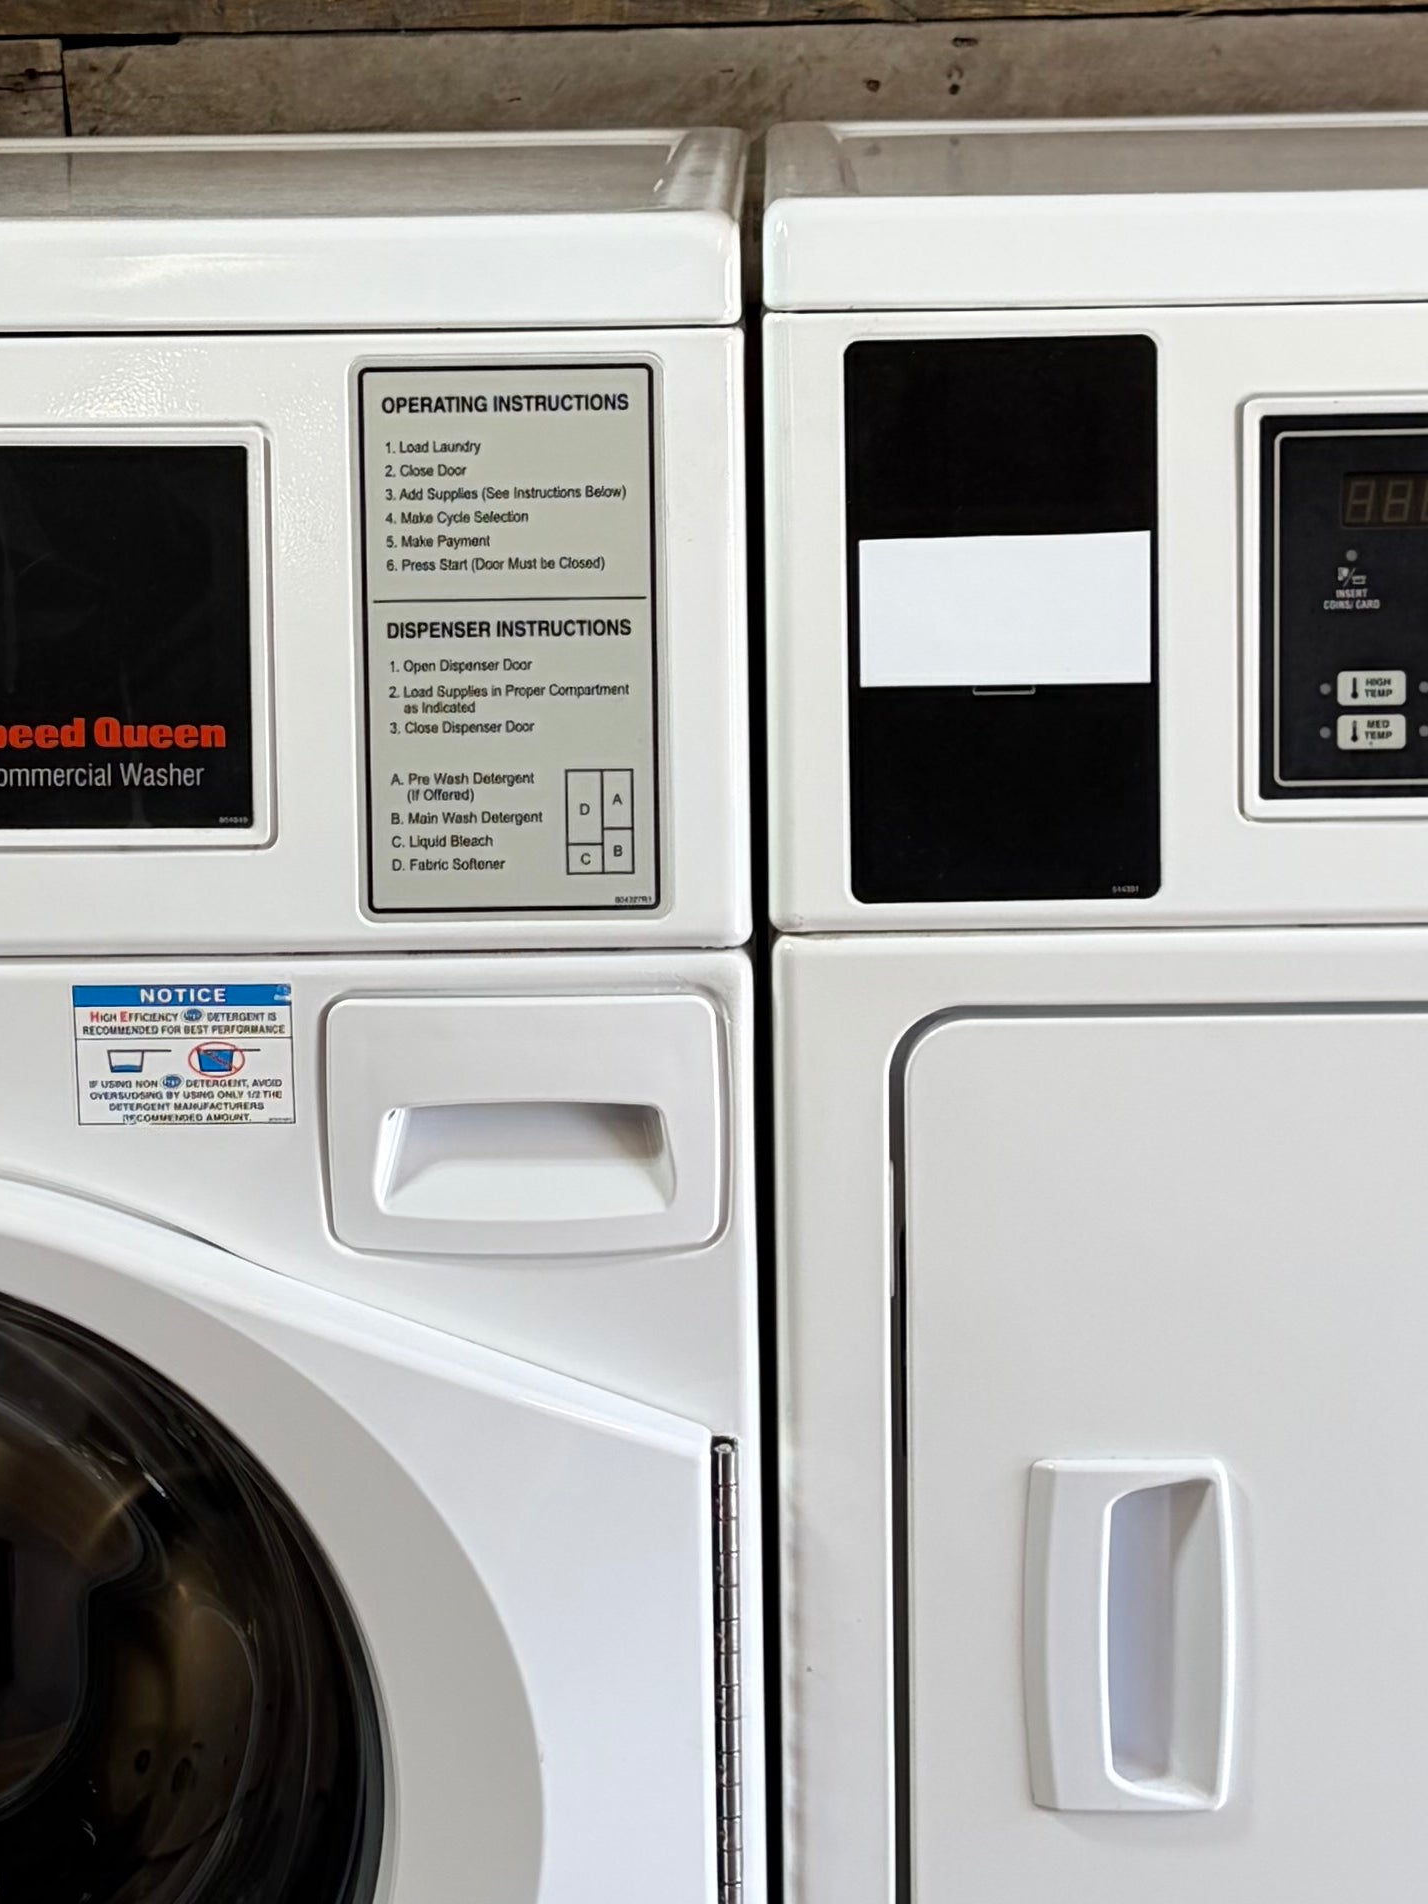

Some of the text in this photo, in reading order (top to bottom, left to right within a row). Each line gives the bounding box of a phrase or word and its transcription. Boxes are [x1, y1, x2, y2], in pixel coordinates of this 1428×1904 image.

[380, 393, 630, 414] OPERATING INSTRUCTIONS
[399, 441, 482, 456] Load Laundry
[399, 464, 467, 478] Close Door
[399, 484, 627, 503] Add Supplies (See Instructions Below)
[400, 510, 529, 527] Make Cycle Selection
[401, 534, 491, 550] Make Payment
[401, 555, 606, 573] Press Start (Door Must be Closed)
[386, 618, 632, 640] DISPENSER INSTRUCTIONS
[403, 658, 533, 676] Open Dispenser Door
[1365, 677, 1392, 688] HIGH
[403, 683, 630, 700] Load Supplies in Proper Compartment
[1364, 688, 1393, 698] TEMP
[403, 701, 476, 714] as Indicated
[404, 720, 535, 736] Close Dispenser Door
[1366, 719, 1390, 730] MED
[93, 716, 227, 749] Queen
[1364, 730, 1393, 741] TEMP
[119, 762, 205, 787] Washer
[407, 772, 535, 788] Pre Wash Detergent
[406, 788, 475, 803] (If Offered)
[611, 793, 623, 806] A
[579, 803, 591, 816] D
[407, 811, 543, 827] Main Wash Detergent
[408, 834, 494, 850] Liquid Bleach
[612, 844, 623, 858] B
[409, 857, 506, 872] Fabric Softener
[580, 853, 592, 866] C
[140, 987, 227, 1004] NOTICE
[90, 1011, 117, 1023] HIGH
[120, 1010, 179, 1023] EFFICIENCY
[206, 1011, 265, 1022] DETERGENT
[82, 1024, 286, 1036] RECOMMENDED FOR BEST PERFORMANCE
[101, 1079, 133, 1089] USING
[135, 1079, 158, 1089] NON
[251, 1078, 283, 1088] AVOID
[89, 1090, 283, 1101] OVERSUDSING USING ONLY THE
[108, 1101, 265, 1112] DETERGENT MANUFACTURERS
